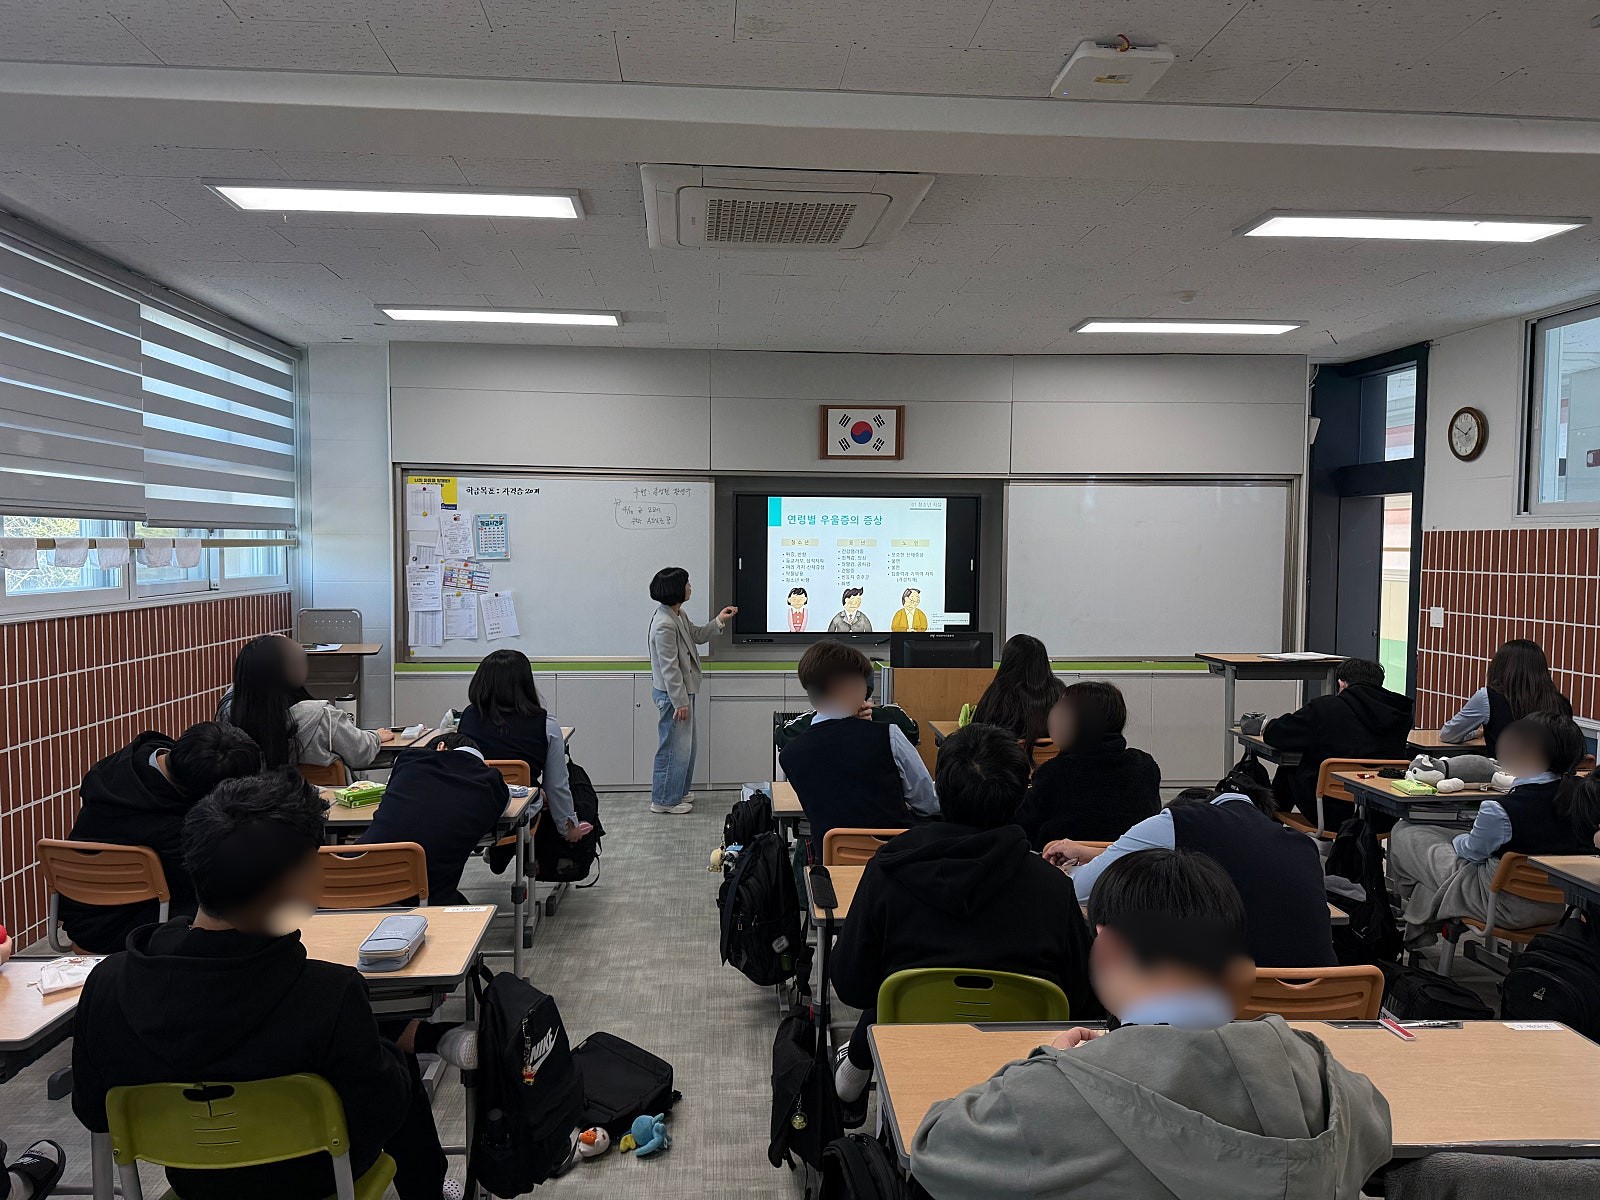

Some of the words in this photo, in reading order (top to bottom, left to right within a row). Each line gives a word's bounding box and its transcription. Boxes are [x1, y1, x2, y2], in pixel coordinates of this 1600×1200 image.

[788, 515, 816, 525] 연령별
[821, 515, 859, 526] 우울증의
[864, 515, 882, 525] 증상
[530, 1027, 552, 1064] NIKE
